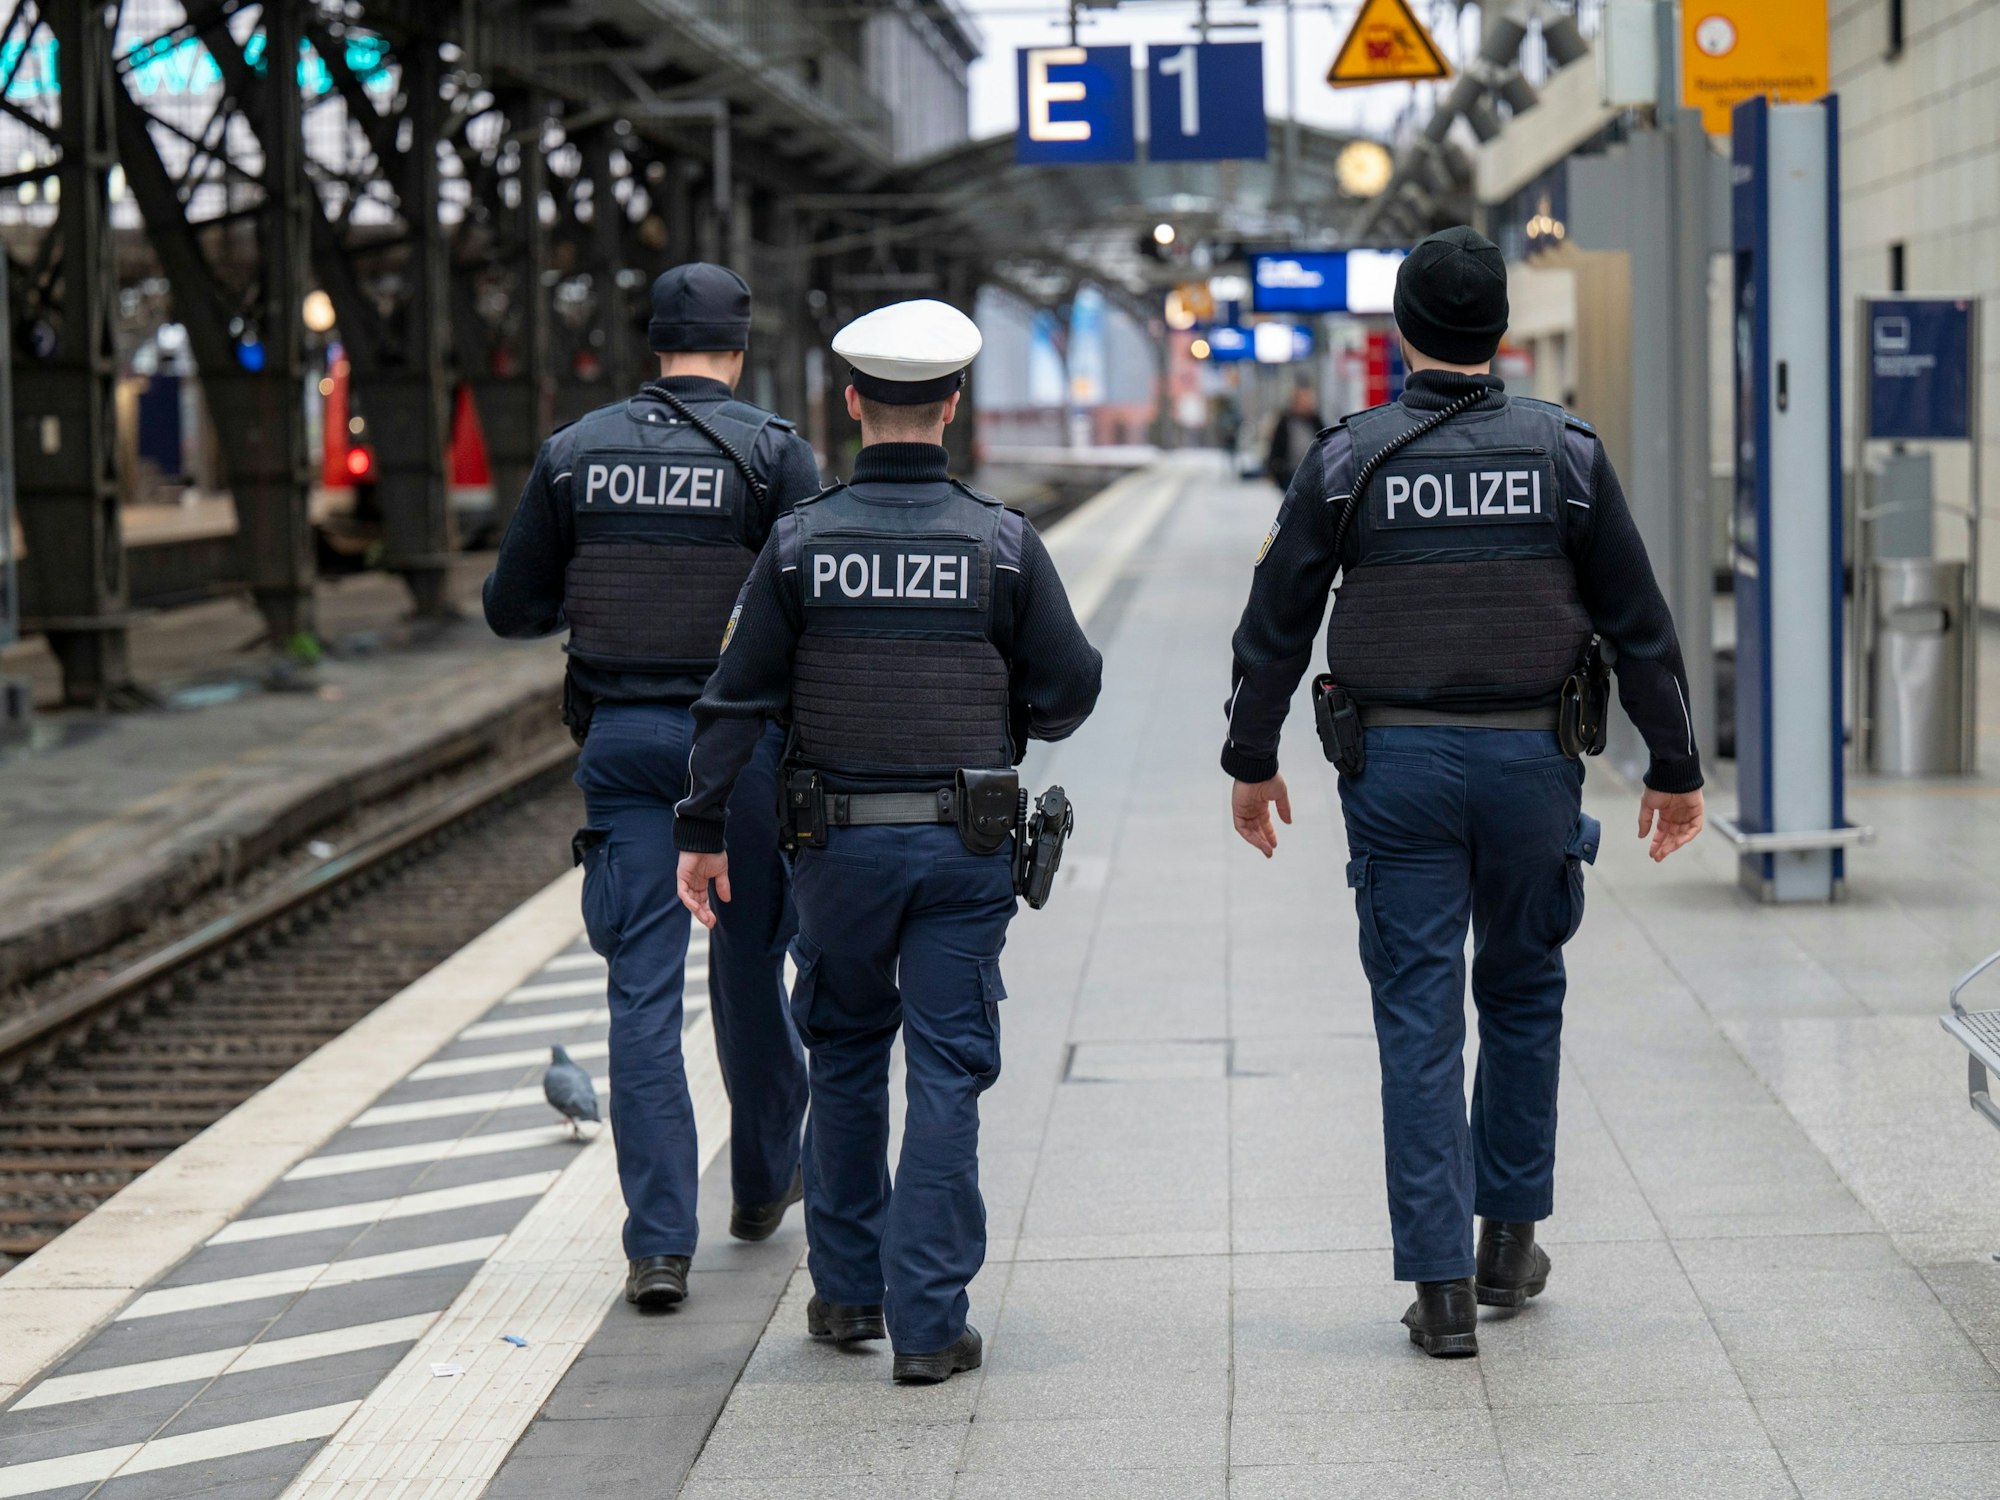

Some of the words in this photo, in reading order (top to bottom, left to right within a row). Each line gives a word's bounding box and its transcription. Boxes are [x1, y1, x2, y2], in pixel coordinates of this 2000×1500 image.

[1027, 48, 1091, 141] E
[1159, 45, 1199, 135] 1
[586, 464, 724, 508] POLIZEI
[1386, 470, 1541, 520] POLIZEI
[813, 553, 969, 599] POLIZEI
